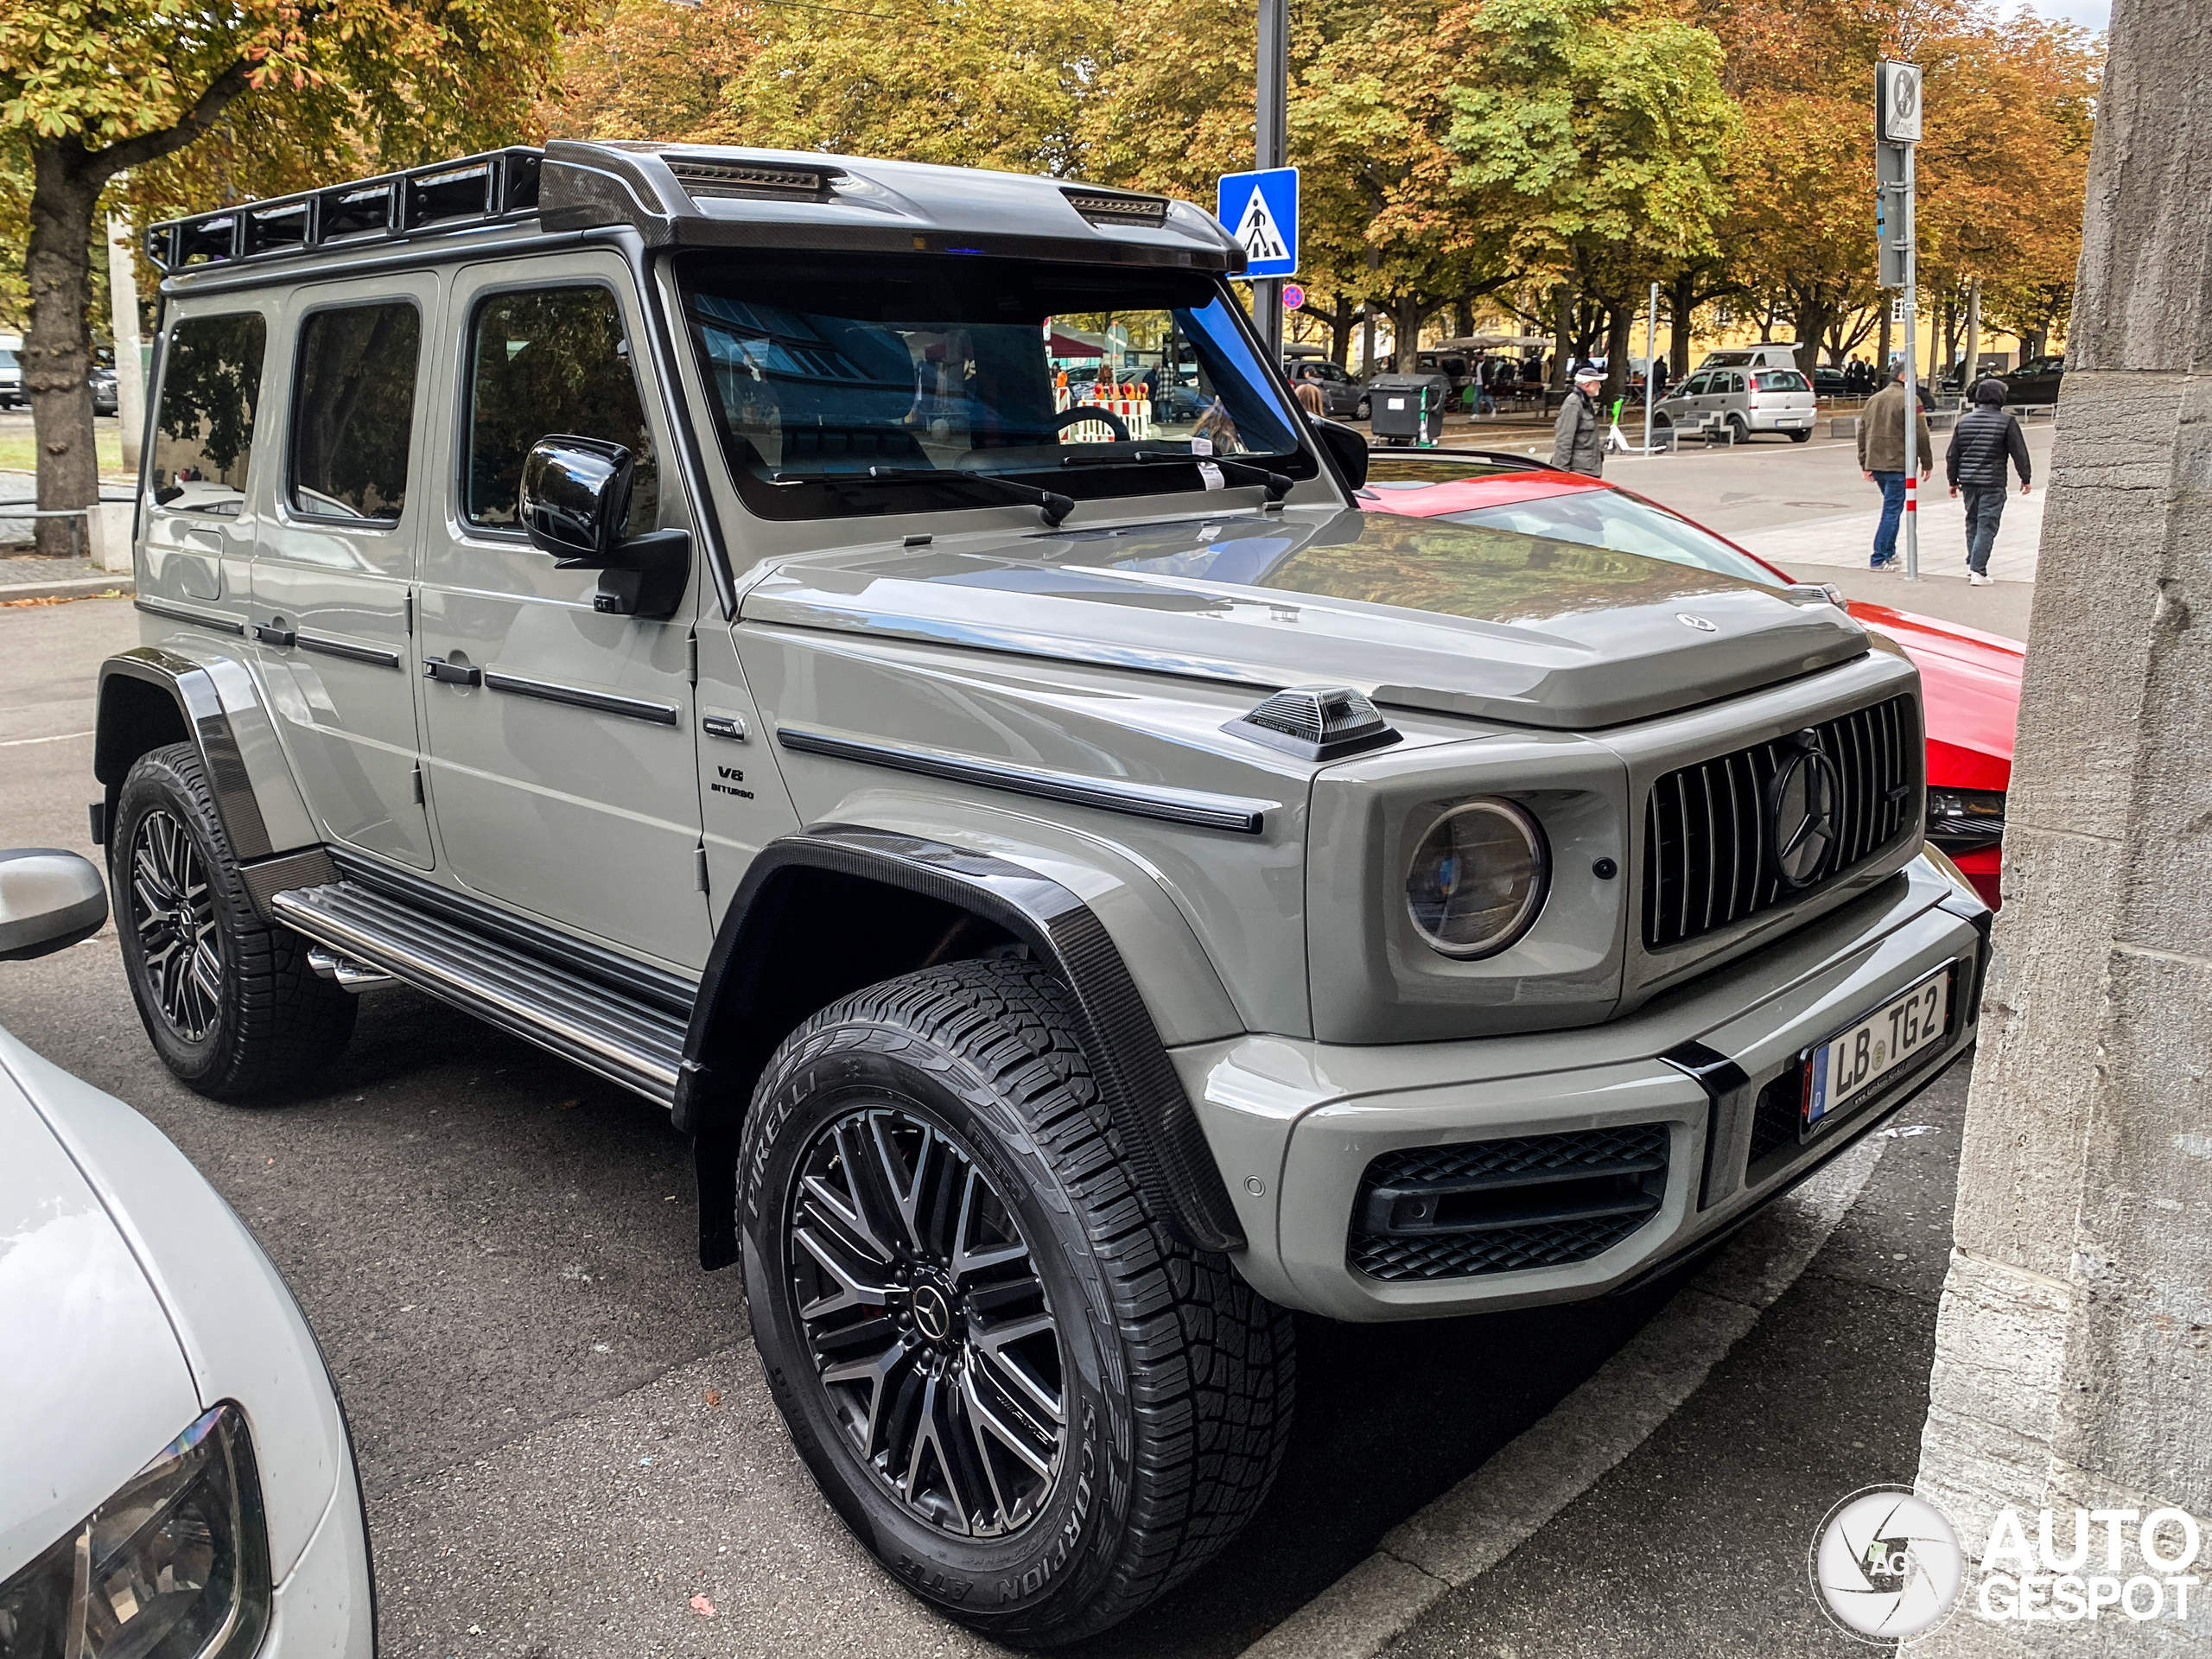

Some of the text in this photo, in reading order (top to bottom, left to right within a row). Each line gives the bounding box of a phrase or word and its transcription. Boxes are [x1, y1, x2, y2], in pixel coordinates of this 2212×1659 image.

[1896, 121, 1914, 136] ZONE
[717, 765, 744, 782] V8
[711, 783, 754, 800] BITURBO
[1835, 1027, 1871, 1097] LB
[1888, 995, 1919, 1059] TG
[1921, 985, 1938, 1040] 2
[1815, 1091, 1821, 1108] D
[747, 1069, 817, 1219] PIRELLI
[997, 1395, 1096, 1604] SCORPION
[897, 1553, 974, 1600] ATR
